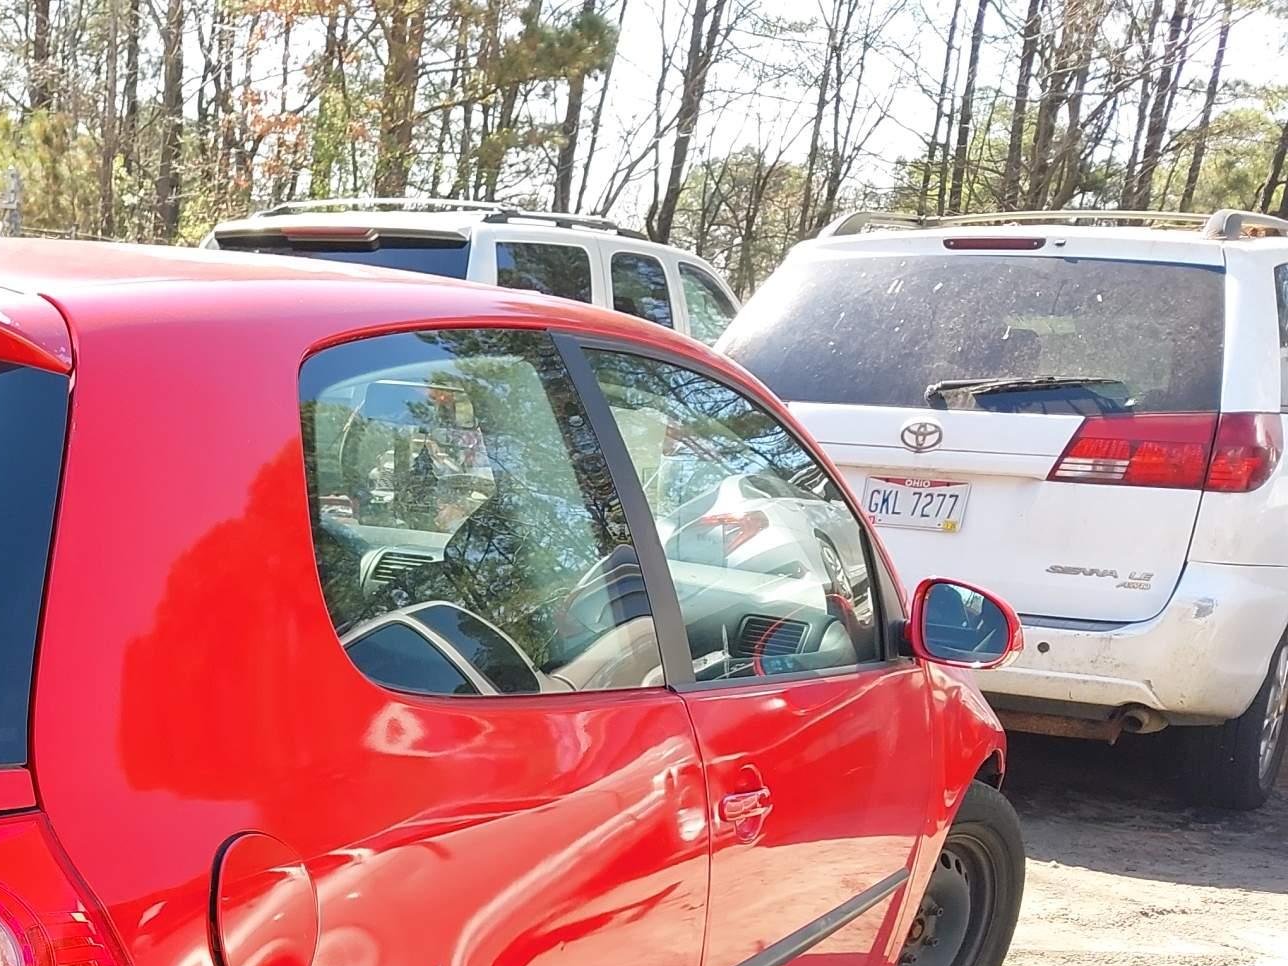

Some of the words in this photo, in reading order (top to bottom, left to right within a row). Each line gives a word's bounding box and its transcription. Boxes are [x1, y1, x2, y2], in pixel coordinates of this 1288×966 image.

[904, 479, 931, 488] OHIO
[868, 489, 901, 515] GKL
[910, 491, 959, 519] 7277
[1128, 571, 1154, 581] LE
